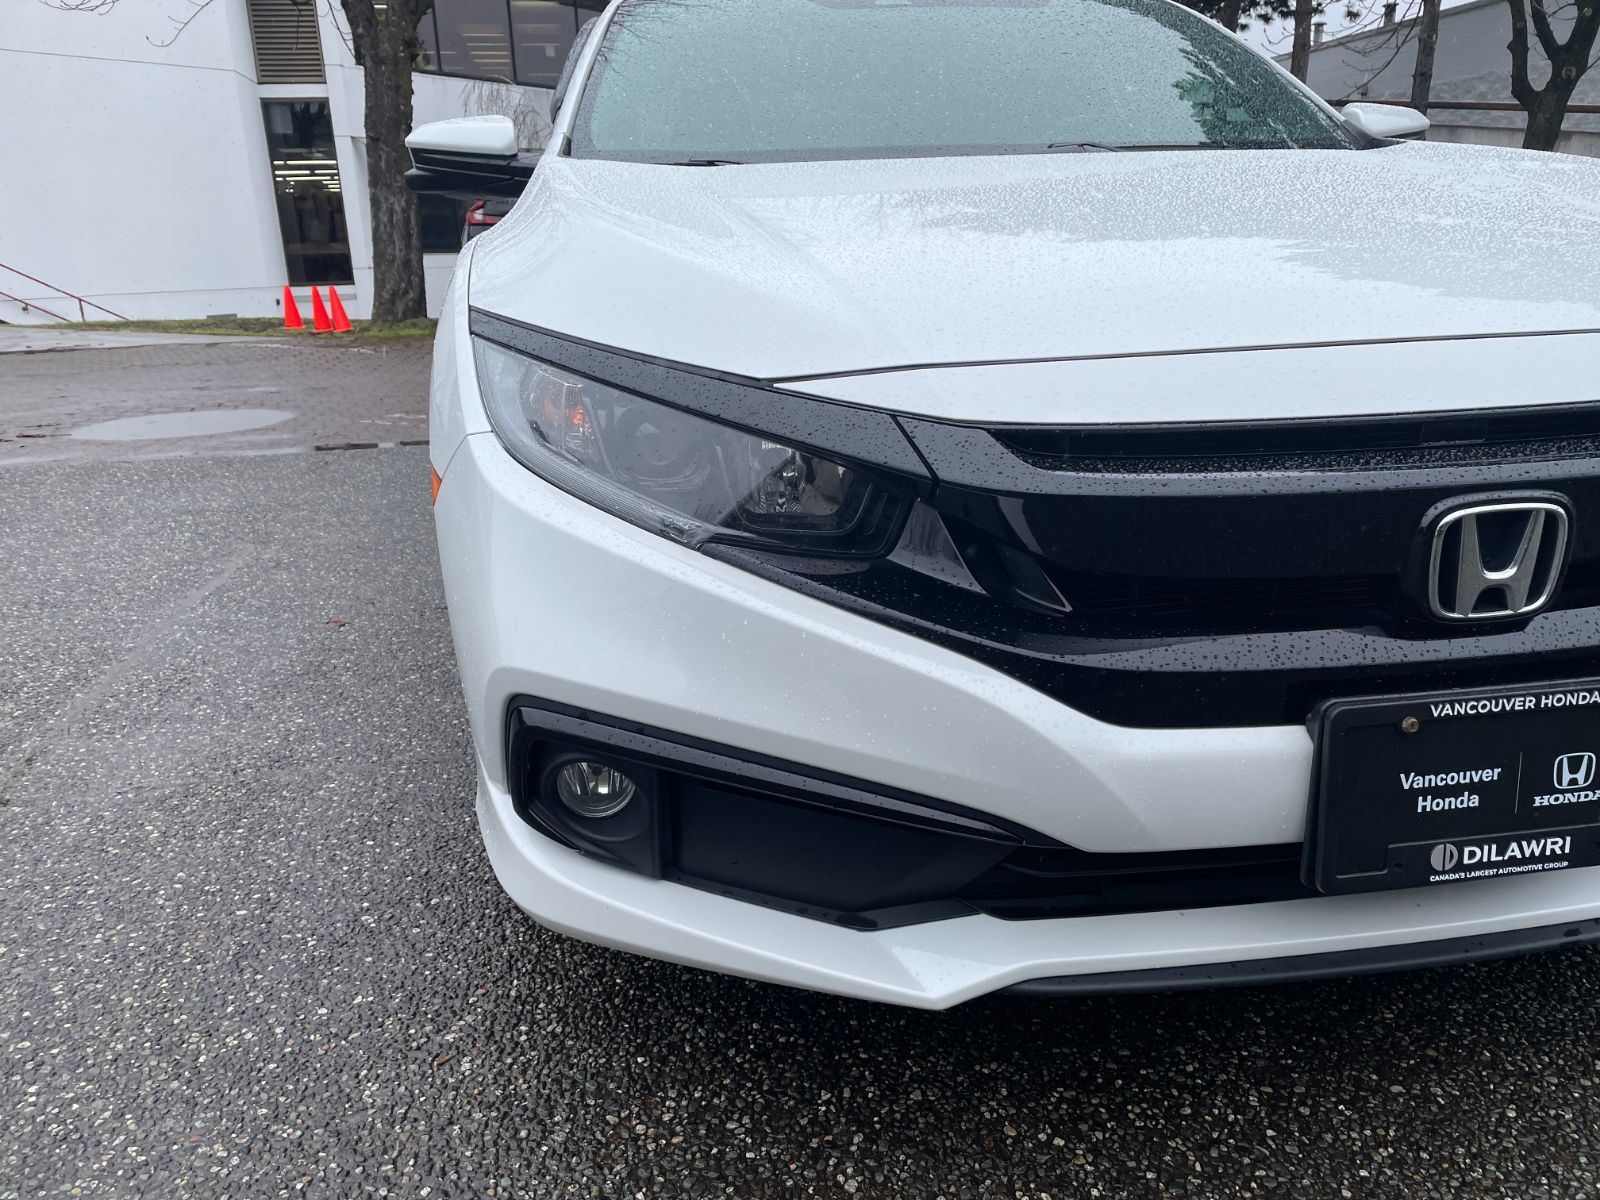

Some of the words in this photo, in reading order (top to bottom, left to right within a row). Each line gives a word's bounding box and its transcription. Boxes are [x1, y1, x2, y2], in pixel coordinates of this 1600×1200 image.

[1430, 696, 1535, 717] VANCOUVER
[1541, 691, 1600, 708] HONDA
[1400, 767, 1502, 790] Vancouver
[1417, 792, 1480, 813] Honda
[1533, 791, 1600, 807] HONDA
[1463, 836, 1571, 865] DILAWRI
[1430, 872, 1465, 882] CANADA'S
[1466, 869, 1497, 879] LARGEST
[1498, 864, 1542, 875] AUTOMOTIVE
[1543, 861, 1568, 870] GROUP
